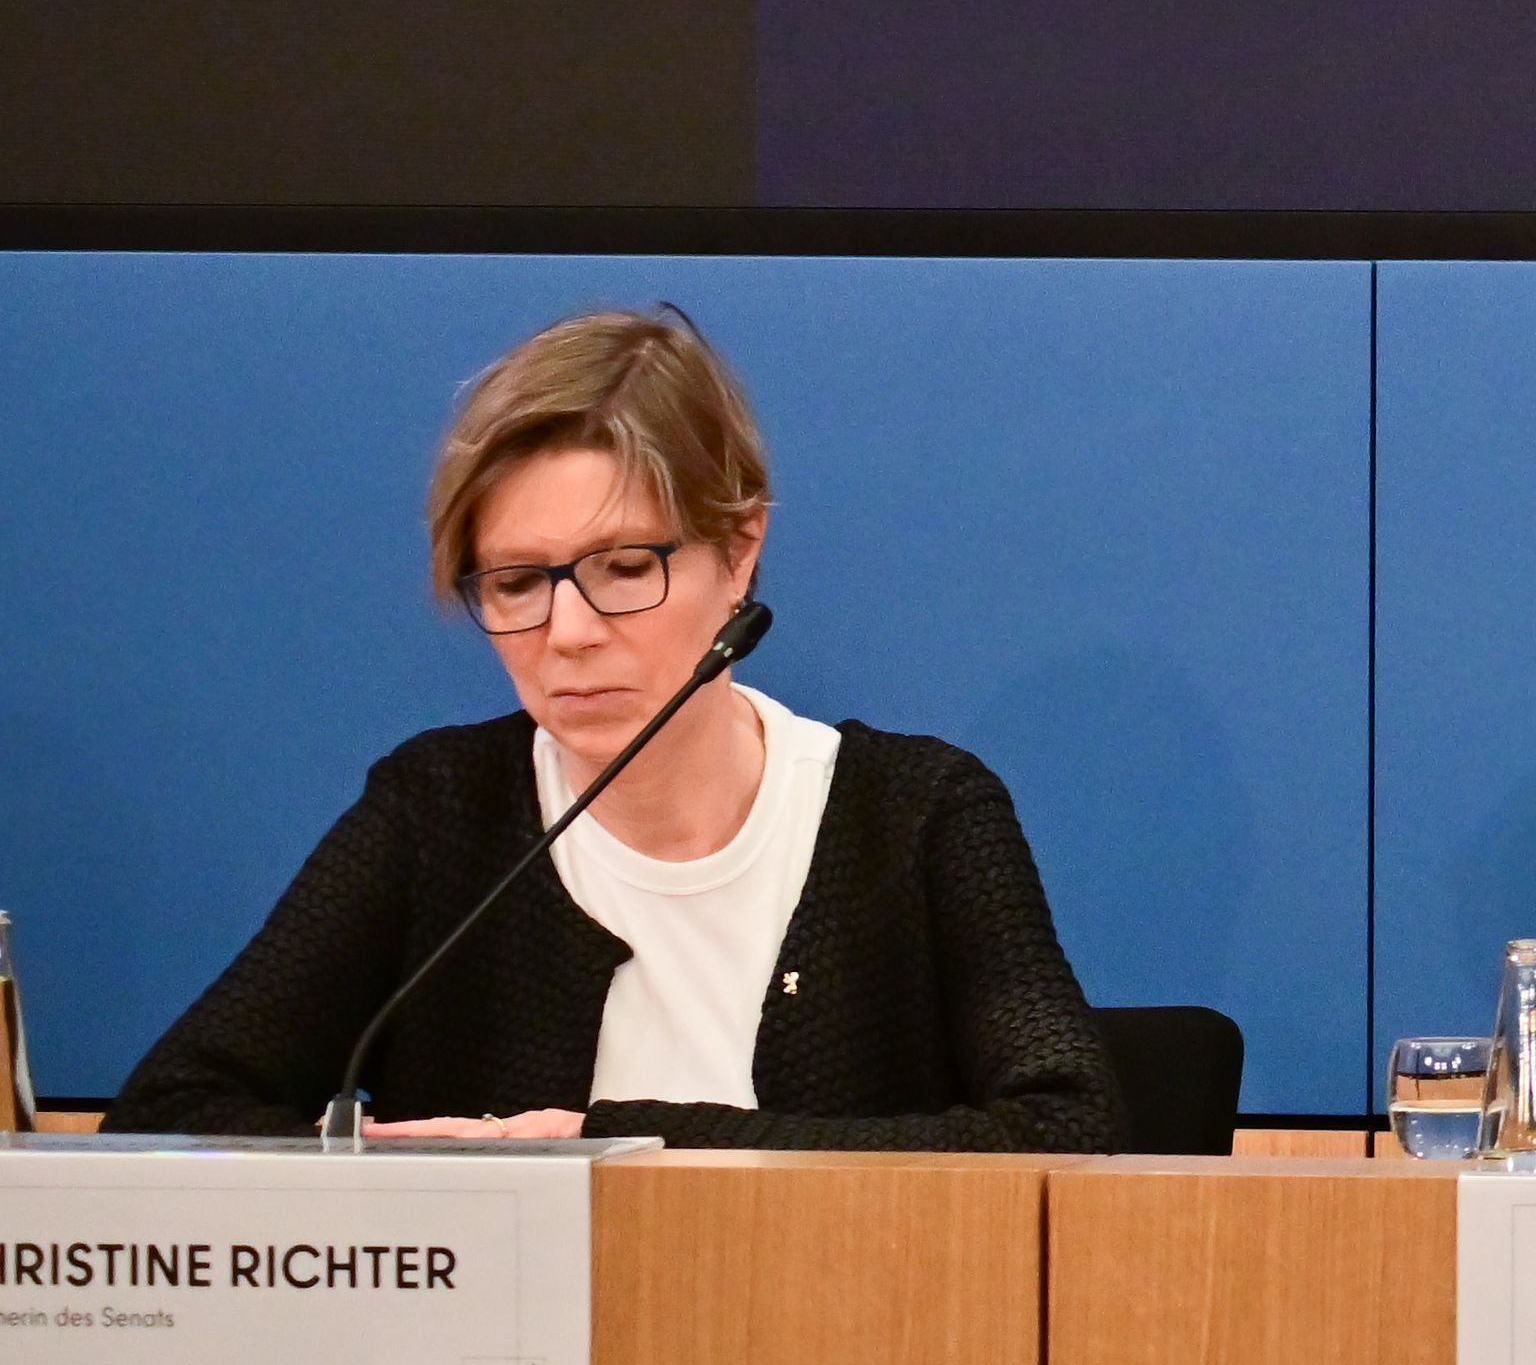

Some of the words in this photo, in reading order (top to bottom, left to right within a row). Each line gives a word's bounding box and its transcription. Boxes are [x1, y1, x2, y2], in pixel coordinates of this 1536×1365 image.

[0, 1242, 212, 1287] RISTINE
[231, 1244, 457, 1290] RICHTER
[56, 1304, 94, 1327] des
[101, 1306, 175, 1328] Senats
